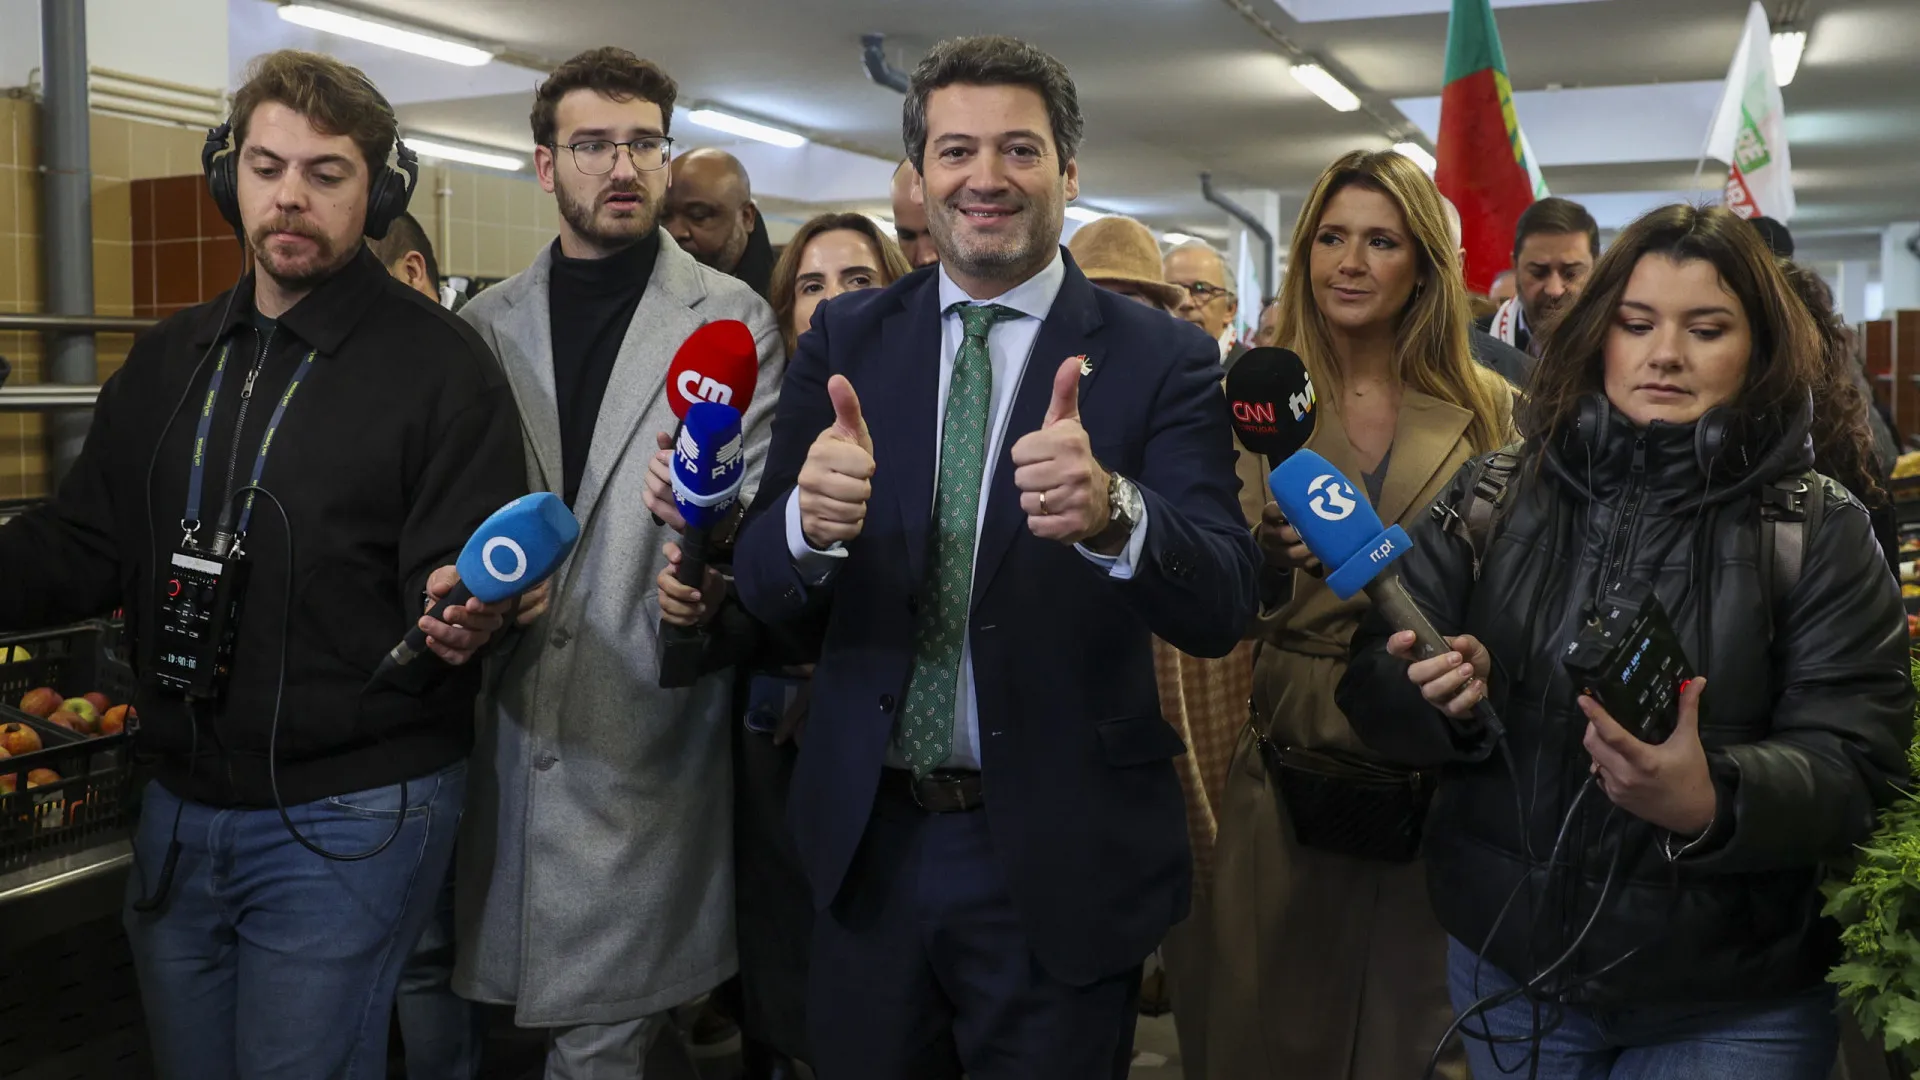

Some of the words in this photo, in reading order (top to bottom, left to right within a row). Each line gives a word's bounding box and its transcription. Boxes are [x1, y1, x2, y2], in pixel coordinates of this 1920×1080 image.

[1288, 371, 1316, 422] tvi
[1232, 400, 1276, 423] CNN
[1369, 538, 1395, 563] rr.pt
